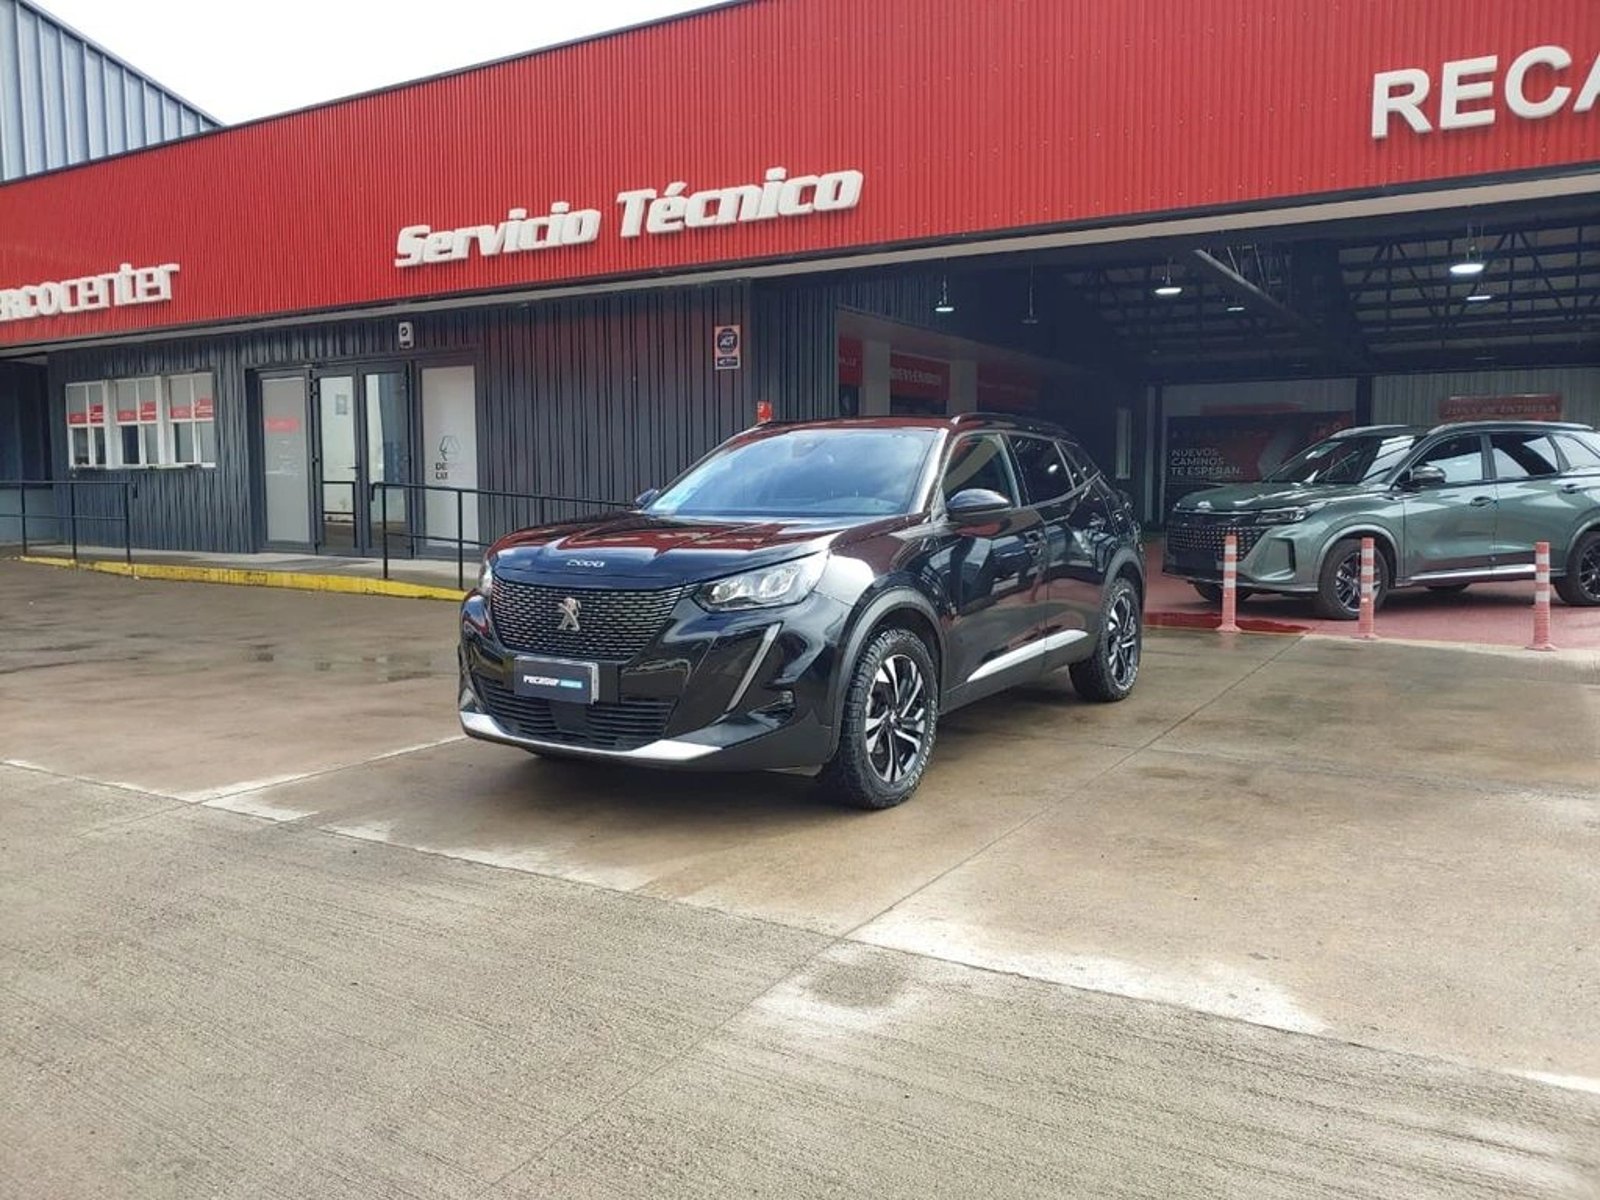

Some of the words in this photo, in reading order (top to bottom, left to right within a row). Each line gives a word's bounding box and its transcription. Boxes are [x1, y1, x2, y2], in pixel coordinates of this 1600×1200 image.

[394, 201, 602, 267] Servicio
[616, 166, 864, 238] Técnico
[1171, 447, 1219, 457] NUEVOS
[1171, 457, 1225, 466] CAMINOS
